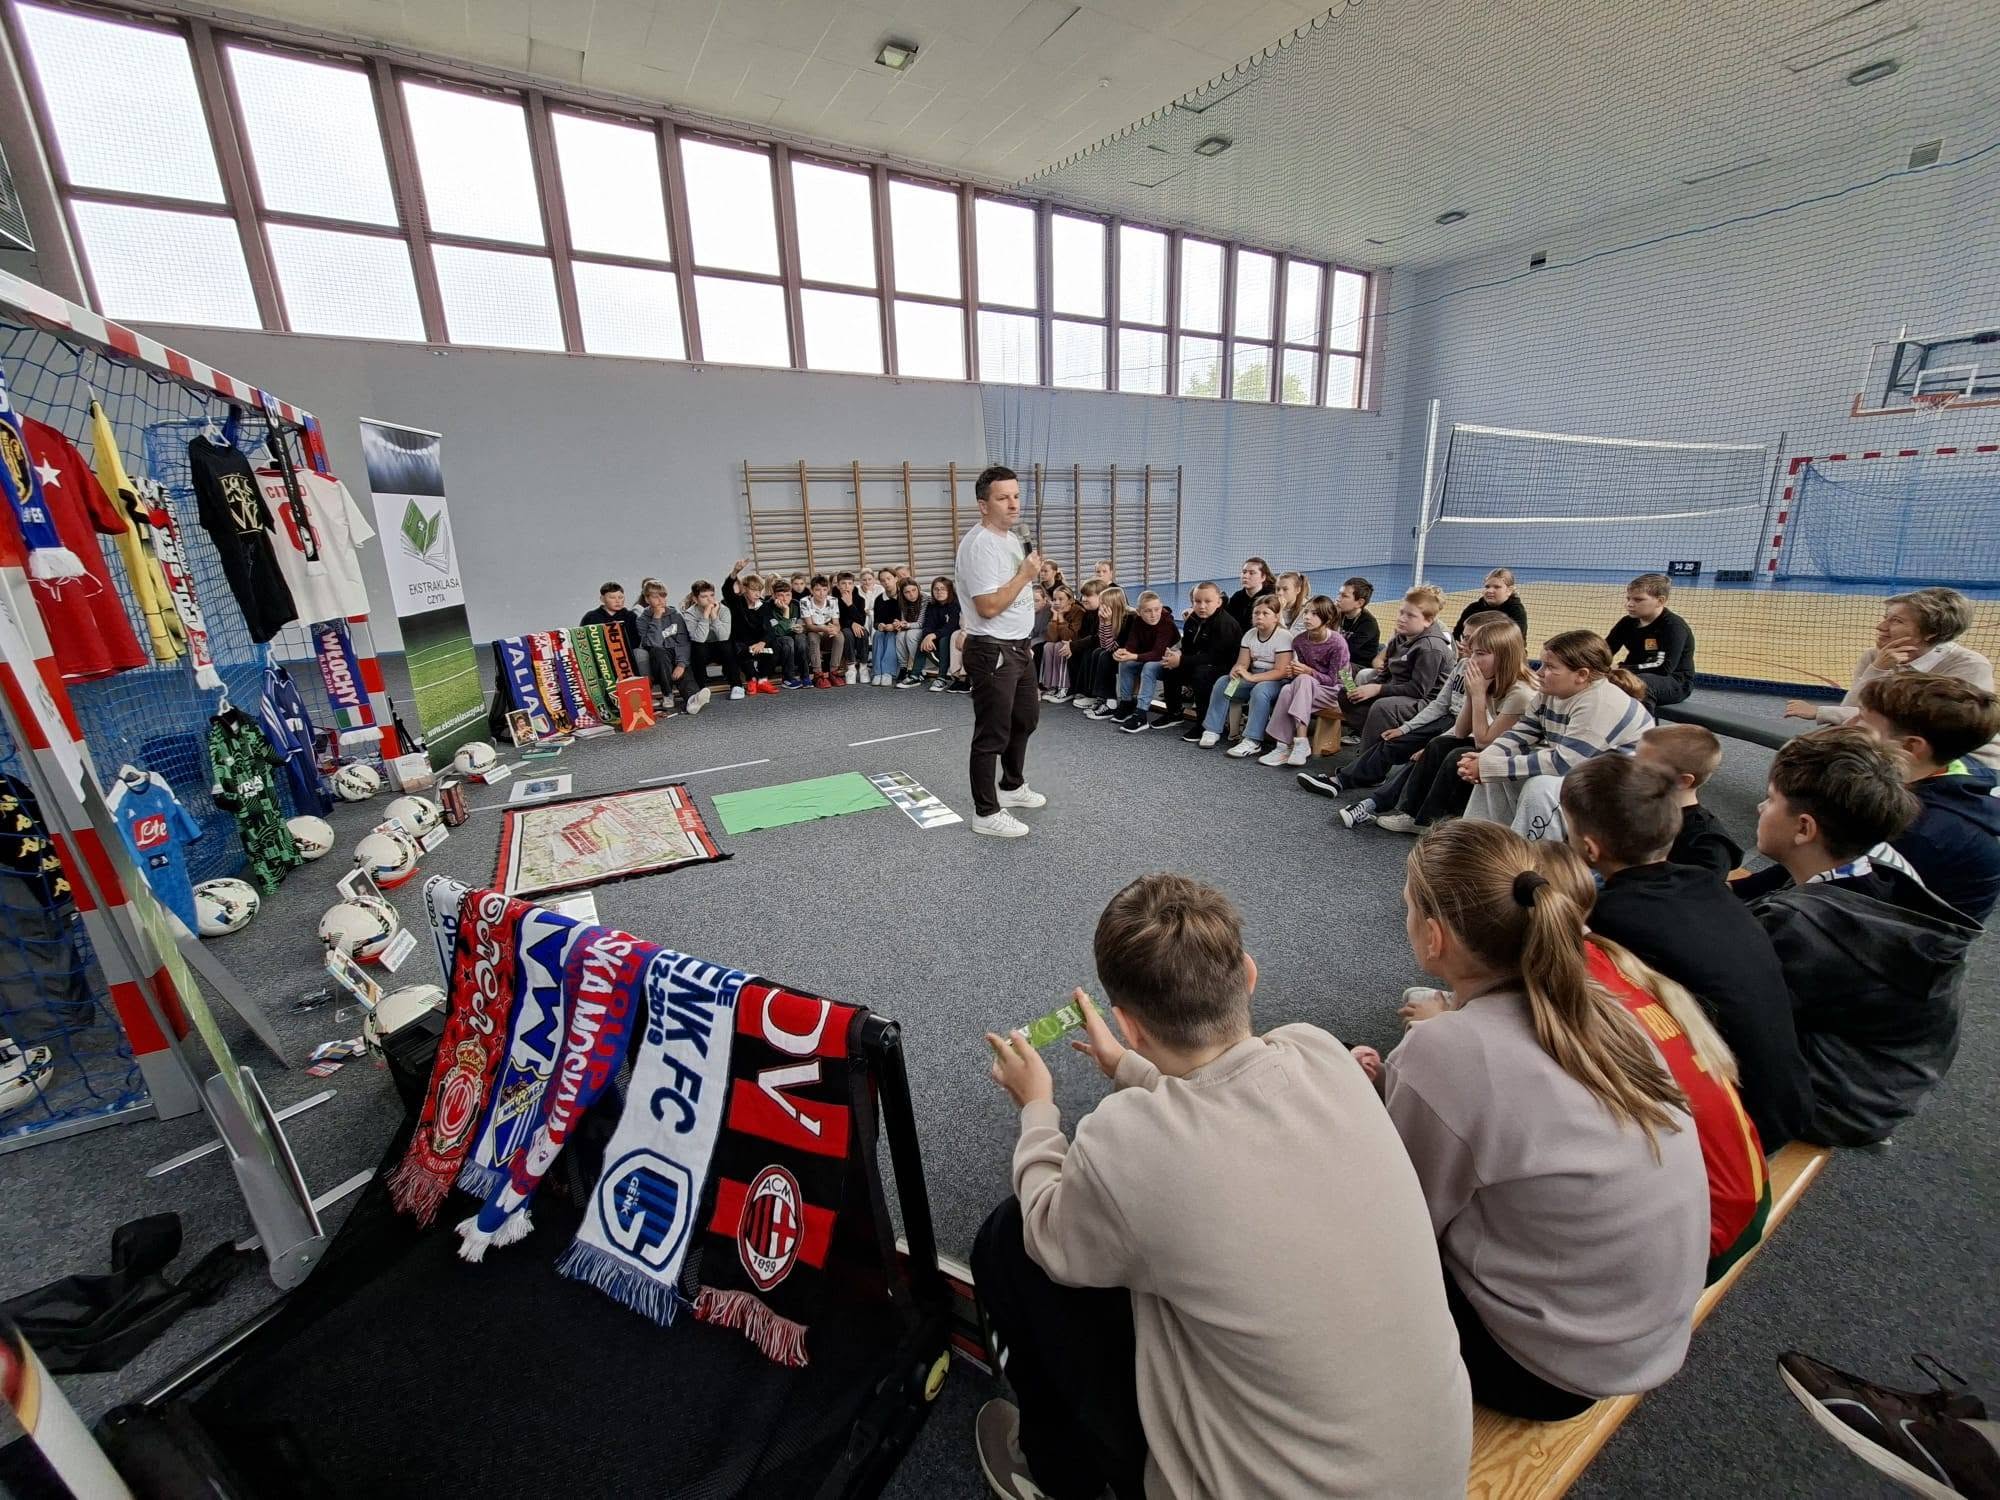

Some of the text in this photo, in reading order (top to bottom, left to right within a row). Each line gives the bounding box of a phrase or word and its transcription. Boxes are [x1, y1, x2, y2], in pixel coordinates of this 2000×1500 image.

[408, 577, 461, 596] EKSTRAKLASA
[426, 595, 446, 605] CZYTA
[321, 630, 360, 705] WŁOCHY
[542, 657, 563, 711] DEUTSCHLAND
[562, 653, 586, 710] CHORWACJA
[595, 653, 614, 688] AFRICA
[136, 819, 169, 847] Lete
[650, 1052, 704, 1134] FC
[620, 1175, 640, 1217] GENK
[761, 1176, 793, 1199] ACM
[753, 1254, 777, 1274] 1899
